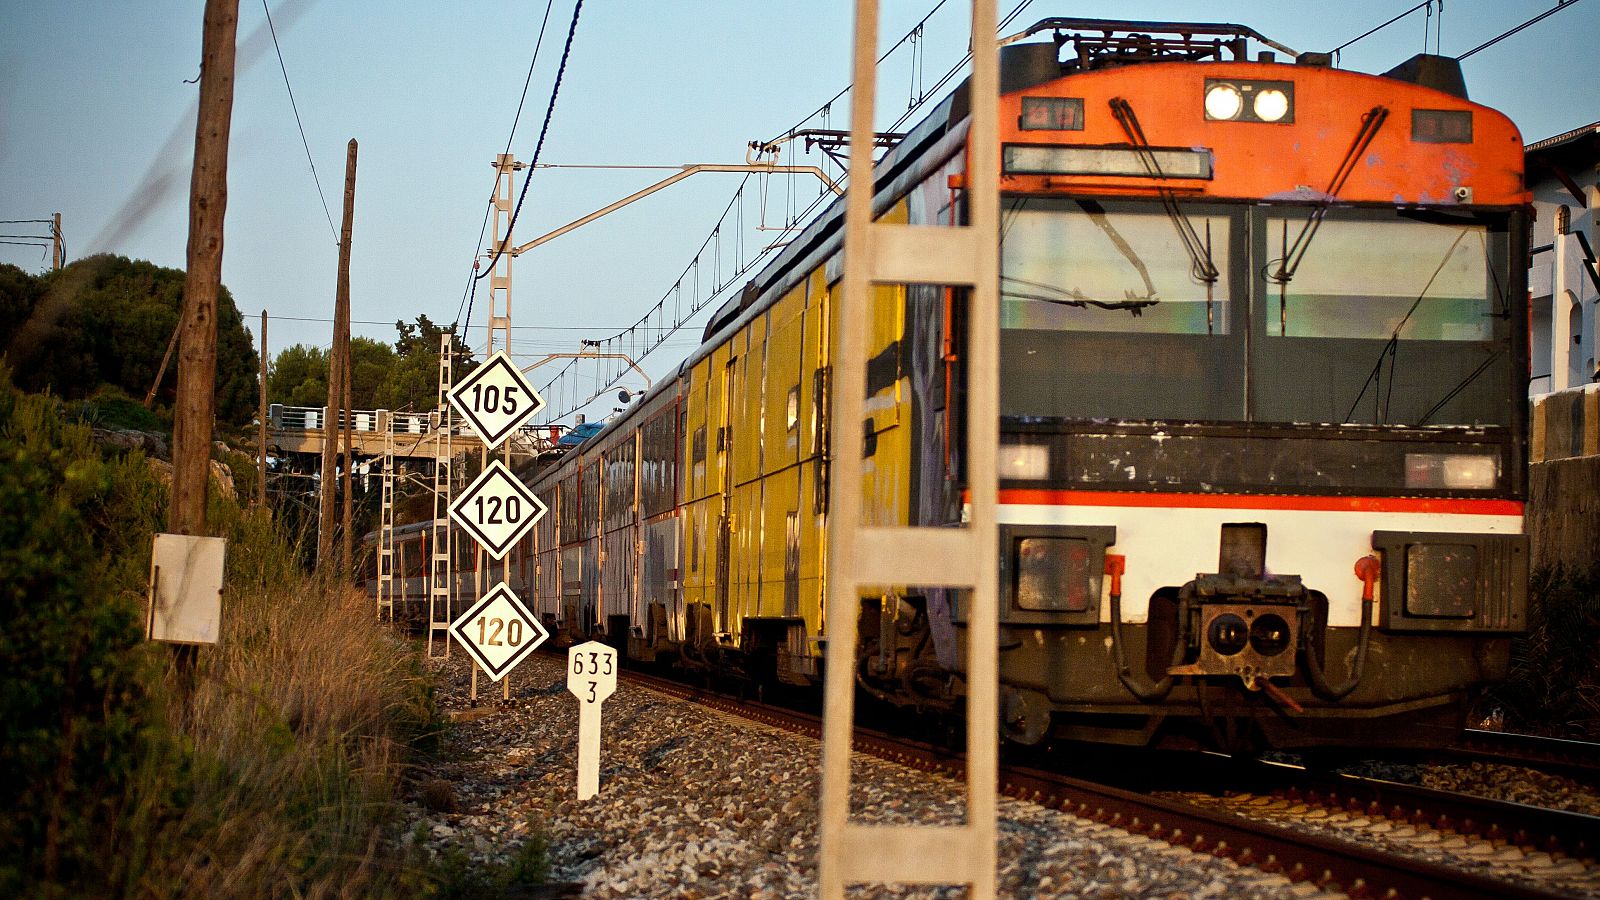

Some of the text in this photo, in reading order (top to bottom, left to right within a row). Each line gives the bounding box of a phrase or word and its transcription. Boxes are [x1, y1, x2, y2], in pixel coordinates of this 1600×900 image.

[473, 384, 518, 415] 105
[475, 496, 521, 524] 120
[477, 617, 523, 647] 120
[573, 652, 613, 676] 633
[587, 681, 597, 703] 3
